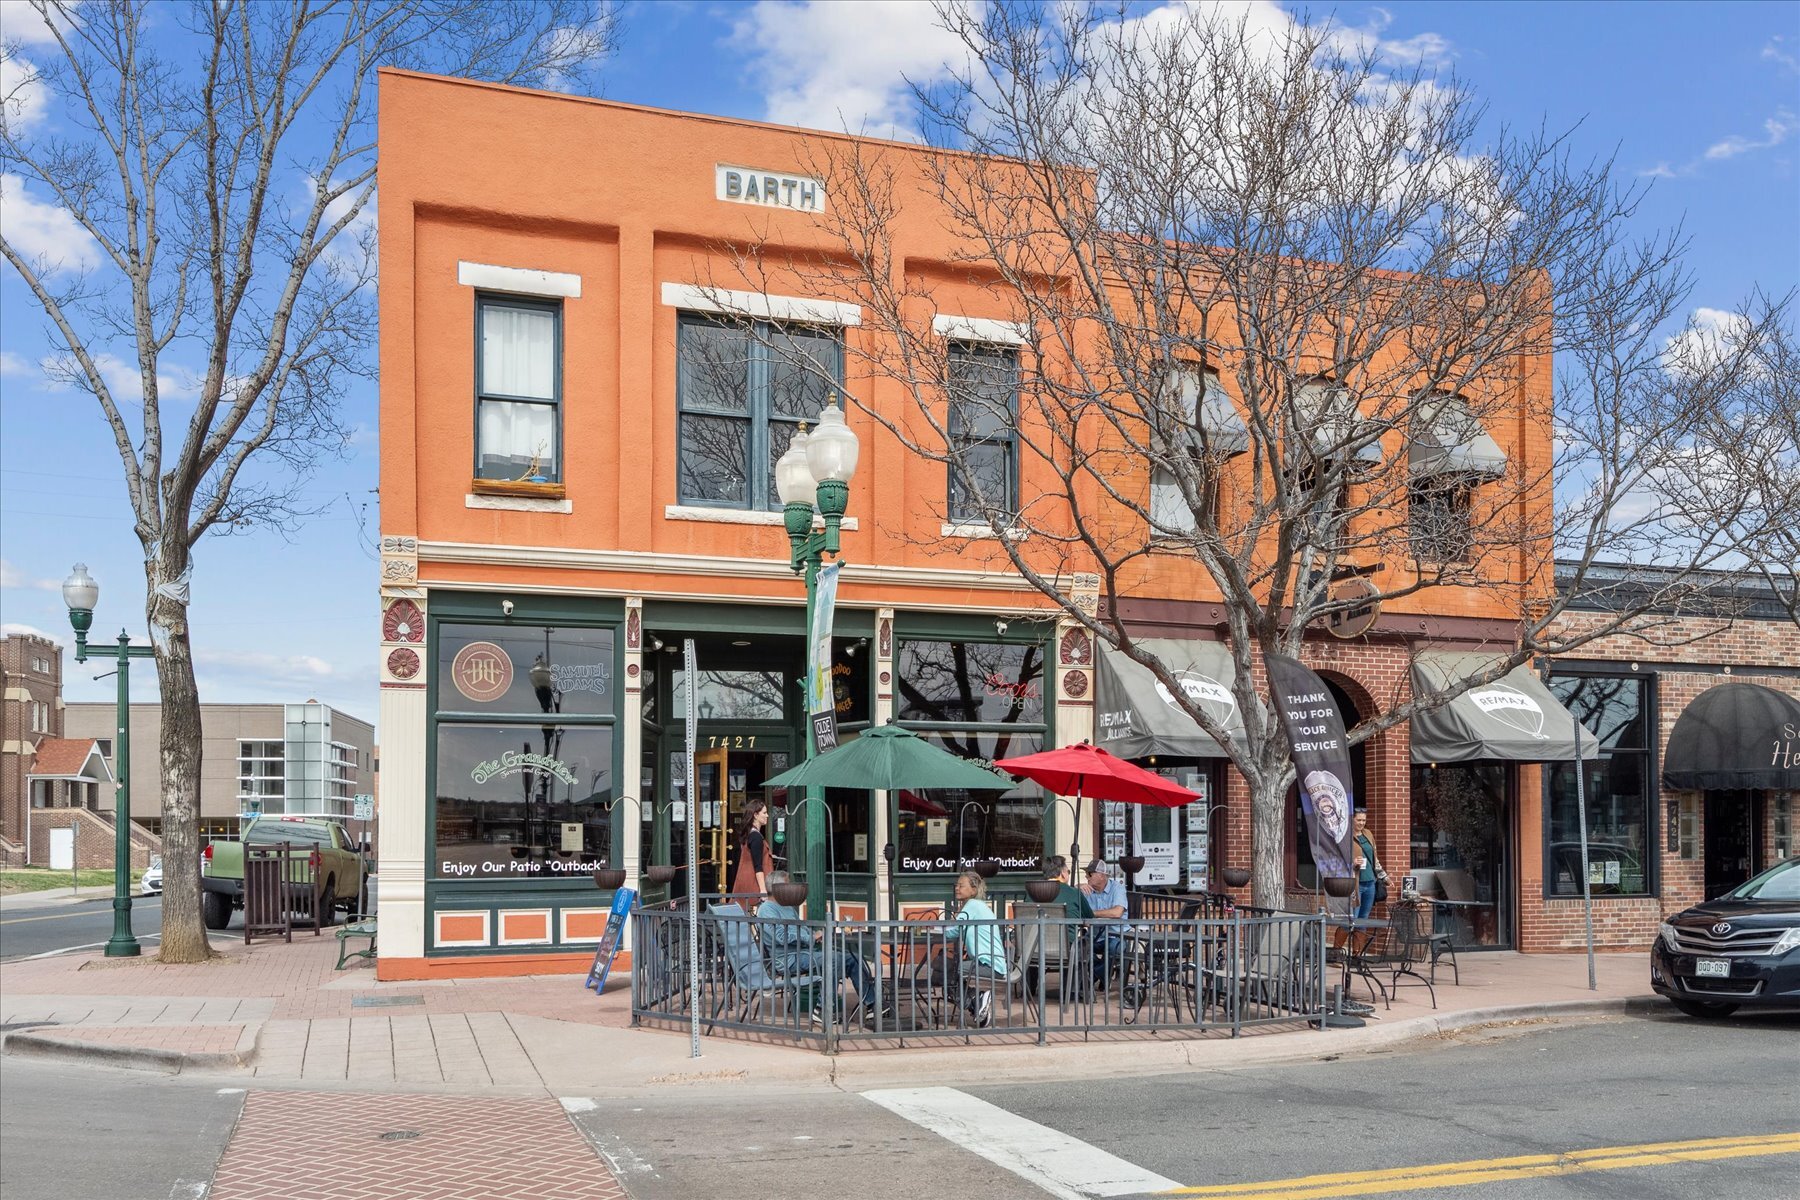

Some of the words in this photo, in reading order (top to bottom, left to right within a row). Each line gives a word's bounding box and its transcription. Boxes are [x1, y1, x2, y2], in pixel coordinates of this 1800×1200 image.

[726, 171, 816, 209] BARTH
[549, 662, 609, 681] SAMUEL
[556, 678, 605, 695] ADAMS
[1002, 696, 1034, 710] OPEN
[1287, 692, 1327, 704] THANK
[1479, 696, 1529, 706] RE/MAX
[1286, 710, 1308, 720] YOU
[1310, 708, 1334, 719] FOR
[816, 720, 832, 735] OLDE
[1298, 725, 1327, 736] YOUR
[709, 735, 756, 749] 7427
[1293, 740, 1338, 752] SERVICE
[471, 759, 500, 785] The
[501, 750, 579, 785] Grandview
[442, 861, 477, 876] Enjoy
[481, 861, 505, 873] Our
[510, 861, 541, 873] Patio
[903, 857, 932, 870] Enjoy
[935, 857, 956, 868] Our
